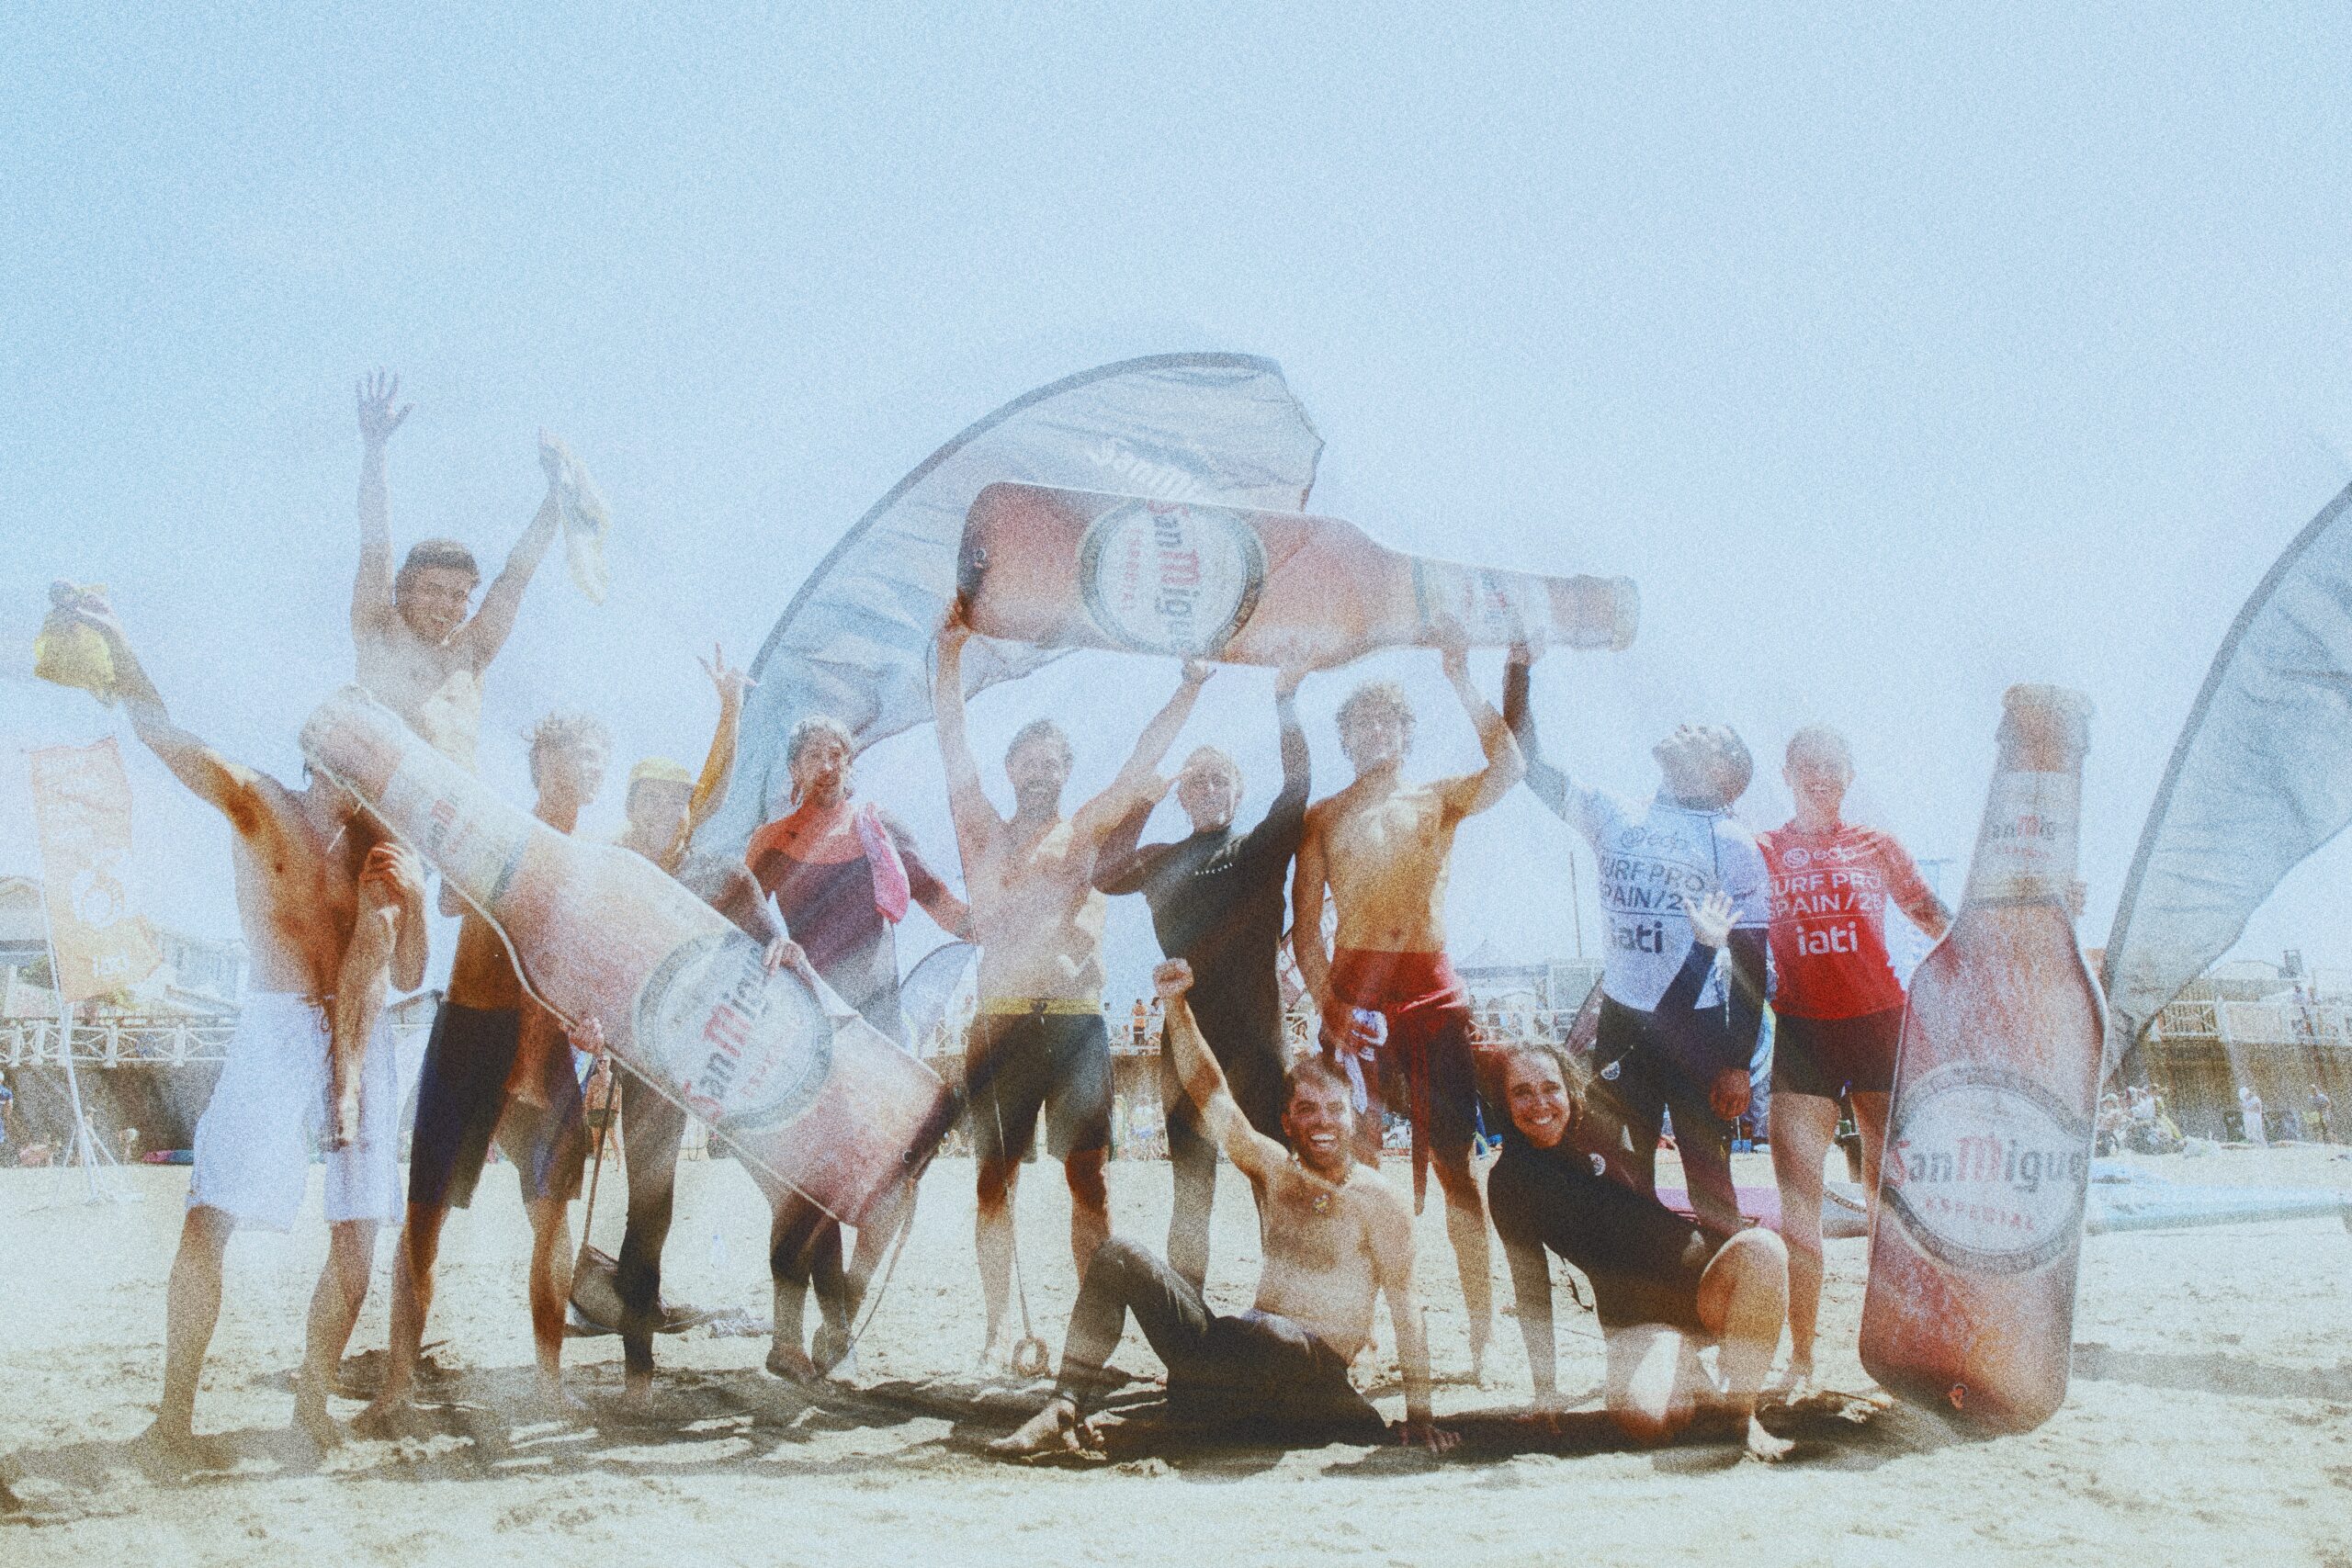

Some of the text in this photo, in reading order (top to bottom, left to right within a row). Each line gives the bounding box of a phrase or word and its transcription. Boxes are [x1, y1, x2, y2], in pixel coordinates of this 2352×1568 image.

[1600, 855, 1705, 892] URF PRO
[1831, 873, 1883, 890] PRO
[1610, 917, 1664, 953] iati
[1795, 921, 1859, 955] iati
[1924, 1196, 2035, 1232] ESPECIAL
